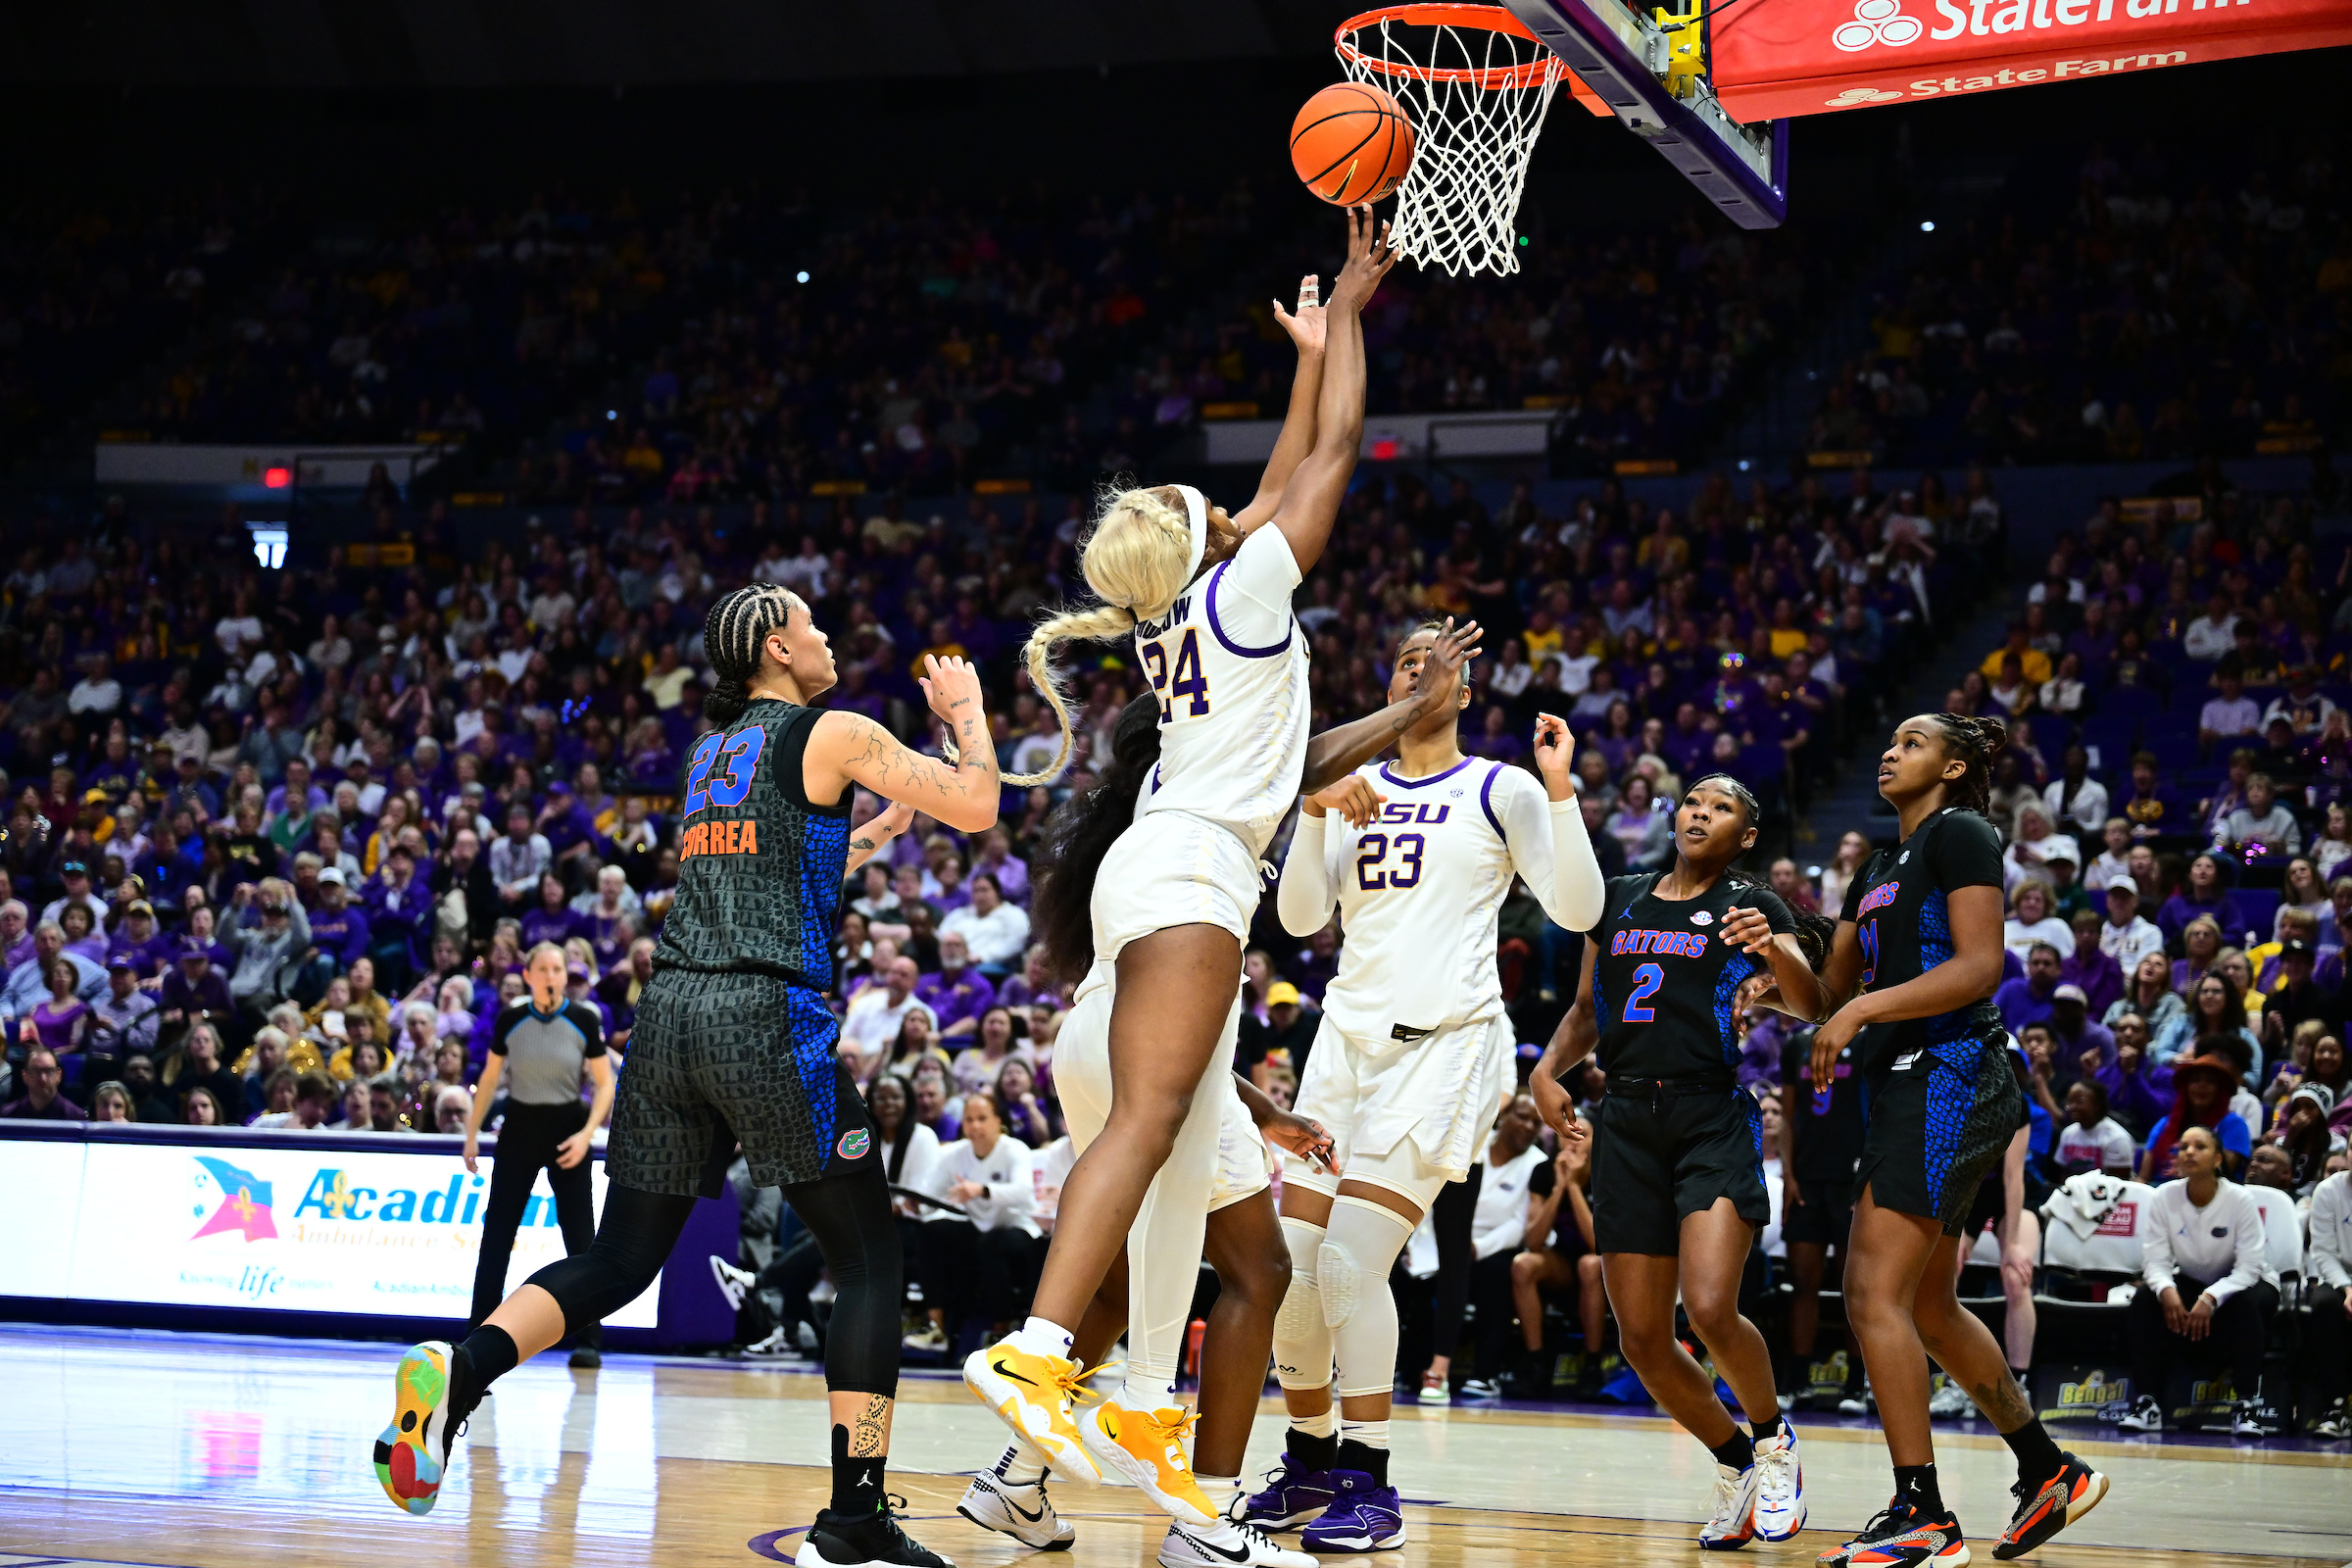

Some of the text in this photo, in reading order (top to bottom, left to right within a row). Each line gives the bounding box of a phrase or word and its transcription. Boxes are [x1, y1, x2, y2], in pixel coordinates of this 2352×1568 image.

[1909, 50, 2187, 96] State Farm
[1142, 626, 1210, 724] 24
[683, 724, 767, 820] 23
[1366, 803, 1452, 825] SU
[1356, 833, 1427, 892] 23
[1610, 928, 1709, 959] GATORS
[1622, 962, 1665, 1023] 2
[293, 1168, 557, 1228] Acadin
[292, 1224, 440, 1250] Ambulance
[238, 1264, 285, 1301] life
[2062, 1381, 2125, 1404] Bengal
